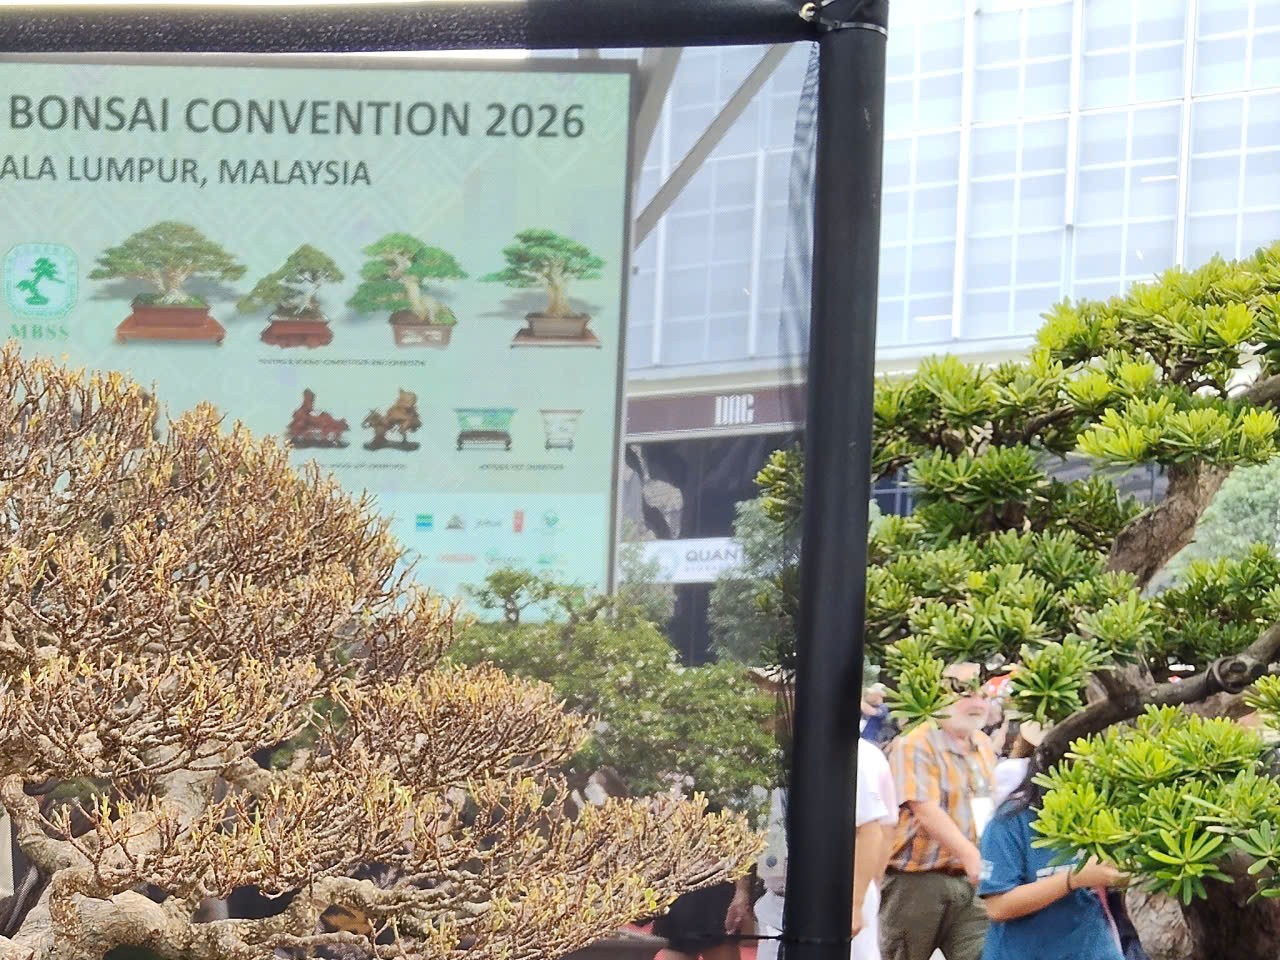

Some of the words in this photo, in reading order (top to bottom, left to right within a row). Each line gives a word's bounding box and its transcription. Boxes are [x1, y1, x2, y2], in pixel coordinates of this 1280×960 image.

[10, 95, 168, 132] BONSAI
[185, 98, 469, 136] CONVENTION
[486, 103, 584, 138] 2026
[69, 156, 207, 188] LUMPUR,
[219, 158, 371, 186] MALAYSIA
[10, 323, 70, 339] MBSS
[685, 548, 738, 562] QUAN
